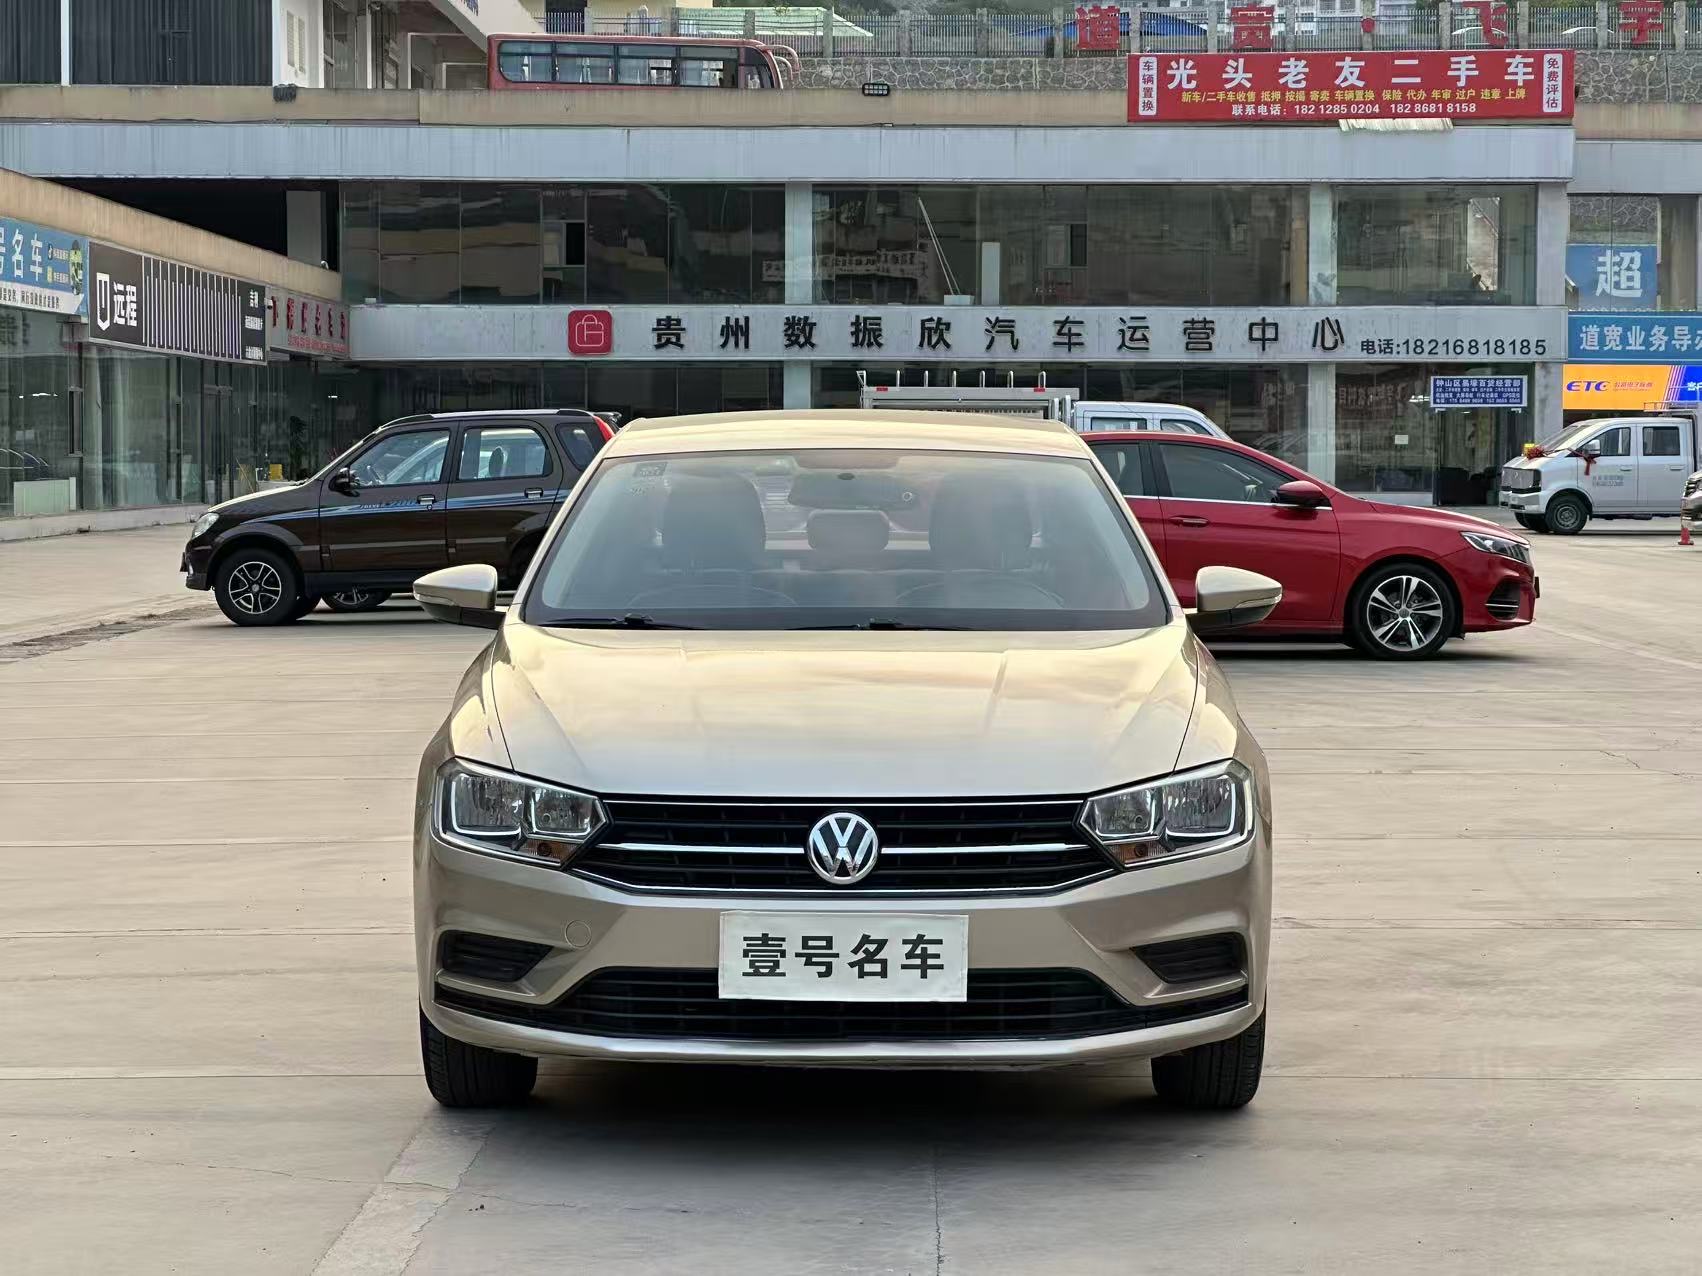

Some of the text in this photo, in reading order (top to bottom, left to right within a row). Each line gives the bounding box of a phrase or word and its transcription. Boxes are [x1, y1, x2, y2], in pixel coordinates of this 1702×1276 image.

[1142, 60, 1155, 113] 车辆置换
[1167, 55, 1535, 89] 光头老友二手车
[1546, 57, 1560, 109] 免费评估
[1261, 90, 1281, 102] 抵押
[1310, 90, 1330, 102] 寄卖
[1334, 89, 1376, 102] 车辆置换
[1382, 89, 1402, 101] 保险
[1406, 89, 1427, 101] 代办
[1431, 89, 1452, 101] 年审
[1455, 89, 1476, 101] 过户
[1480, 89, 1501, 101] 违章
[1505, 88, 1527, 100] 上牌
[1294, 104, 1314, 115] 182
[1319, 104, 1347, 115] 1285
[1351, 104, 1380, 114] 0204
[1390, 103, 1411, 114] 182
[1415, 103, 1443, 114] 8681
[1447, 103, 1477, 114] 8158
[1595, 250, 1643, 298] 超
[113, 281, 138, 327] 远程
[652, 315, 1345, 352] 贵州数振欣汽车运营中心
[1566, 380, 1611, 392] ETC
[741, 932, 945, 979] 壹号名车
